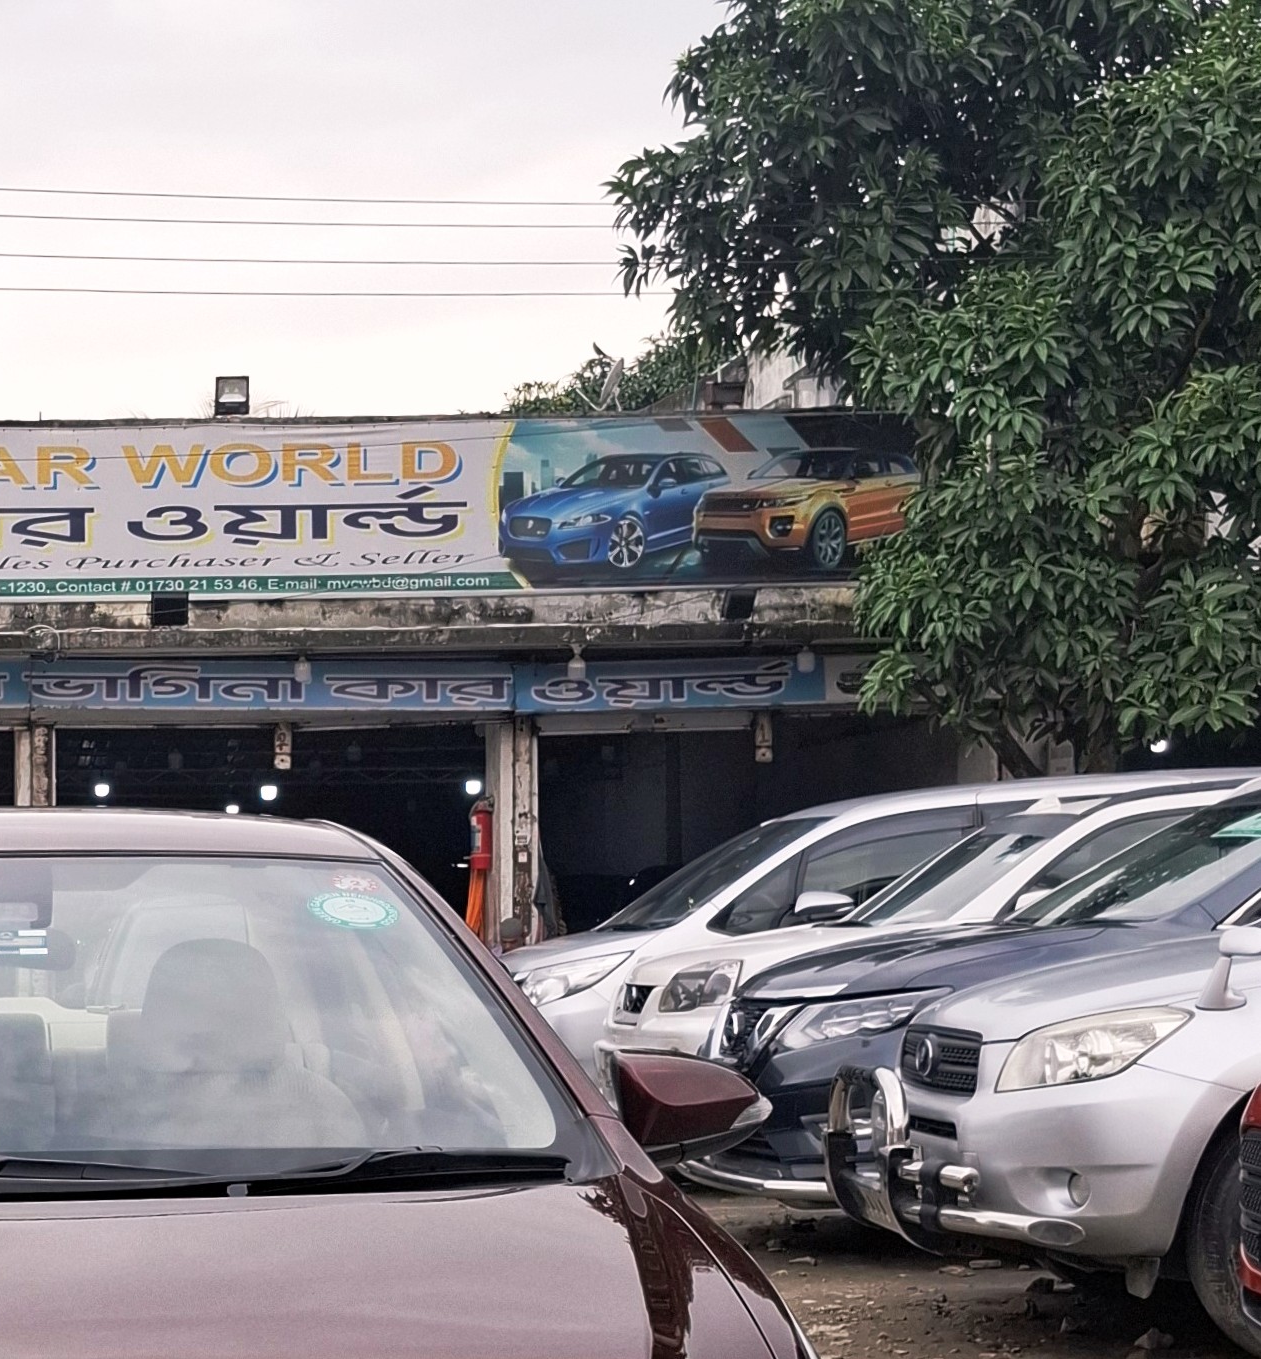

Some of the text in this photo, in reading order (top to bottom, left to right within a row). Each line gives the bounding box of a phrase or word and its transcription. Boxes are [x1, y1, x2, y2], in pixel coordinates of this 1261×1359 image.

[121, 440, 464, 489] WORLD
[65, 551, 282, 572] Purchaser
[293, 551, 341, 568] &
[350, 549, 475, 568] Seller
[55, 580, 117, 593] Contact
[135, 579, 185, 593] 01730
[189, 579, 208, 591] 21
[213, 578, 234, 591] 53
[237, 578, 263, 592] 46,
[23, 665, 310, 703] ভাগিনা
[325, 675, 513, 704] কার
